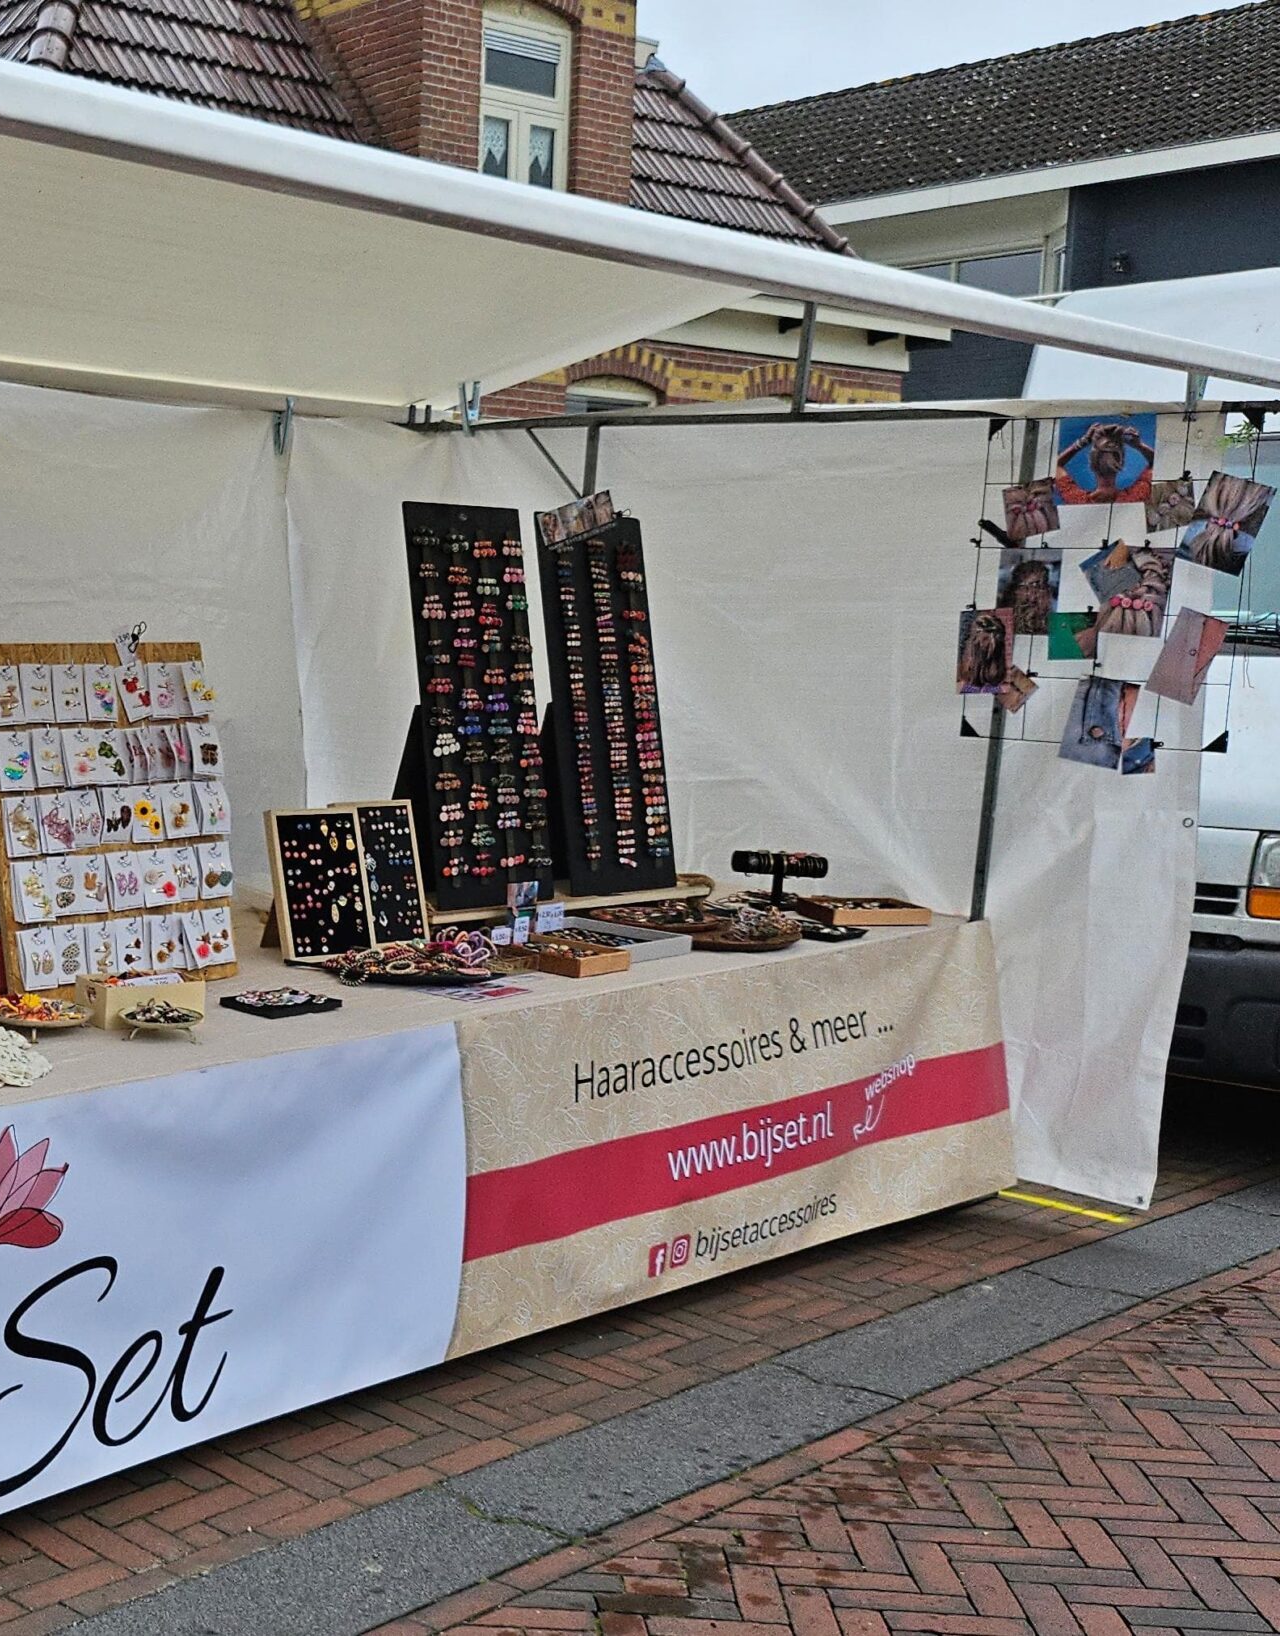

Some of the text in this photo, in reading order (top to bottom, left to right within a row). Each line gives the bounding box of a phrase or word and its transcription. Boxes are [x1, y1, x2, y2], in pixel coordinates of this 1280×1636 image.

[573, 1026, 783, 1103] Haaraccessoires
[788, 1016, 808, 1054] &
[811, 1008, 868, 1051] meer
[864, 1051, 916, 1100] webshop
[667, 1101, 835, 1182] www.bijset.nl
[694, 1189, 838, 1260] bijsetaccessoires
